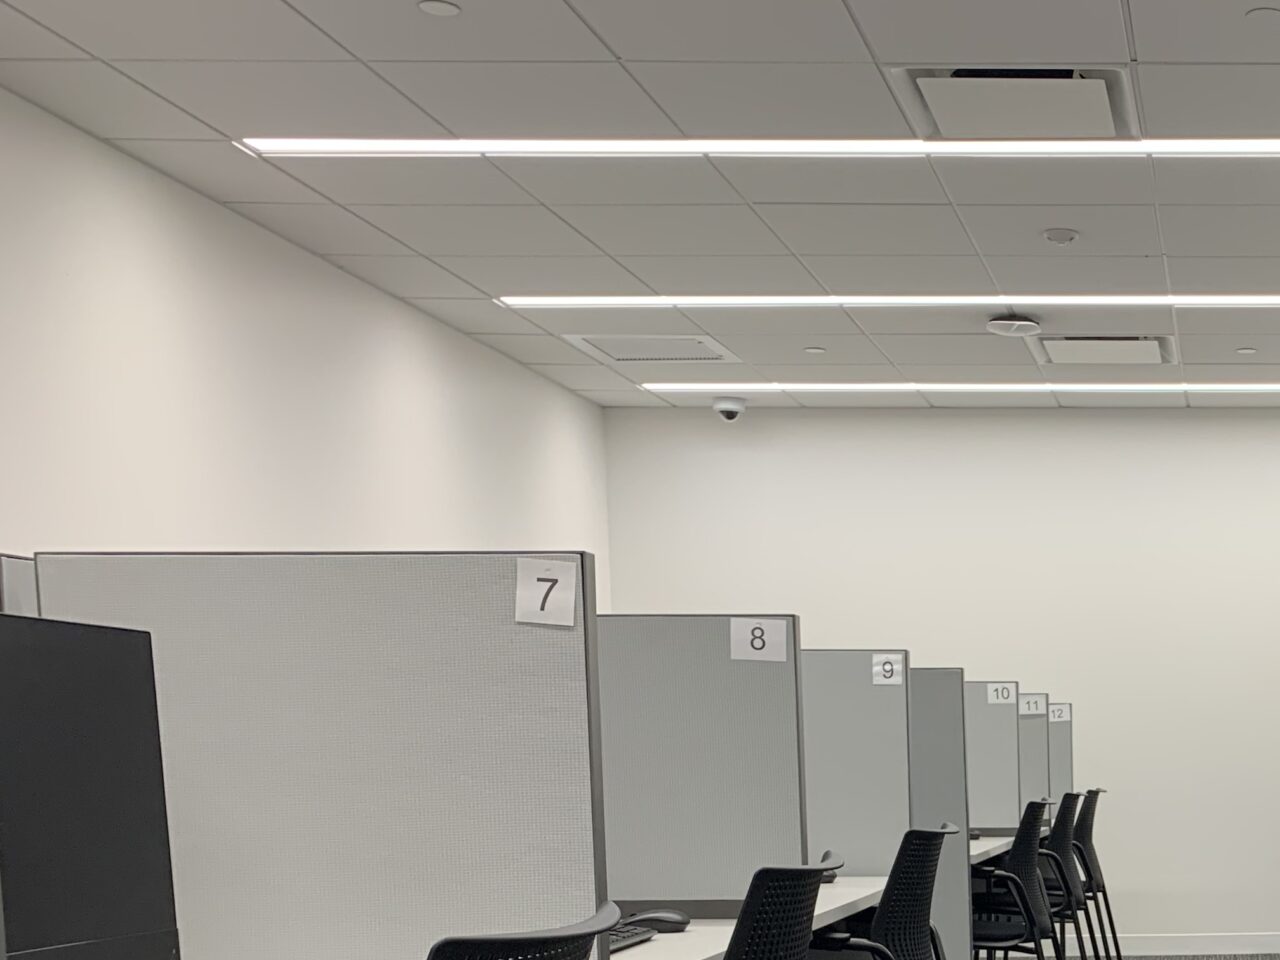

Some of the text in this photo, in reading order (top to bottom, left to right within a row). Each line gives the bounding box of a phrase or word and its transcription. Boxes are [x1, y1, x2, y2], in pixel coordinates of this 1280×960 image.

[536, 577, 558, 612] 7
[750, 626, 766, 651] 8
[882, 661, 895, 679] 9
[993, 687, 1010, 700] 10
[1025, 700, 1039, 711] 11
[1051, 709, 1064, 719] 12
